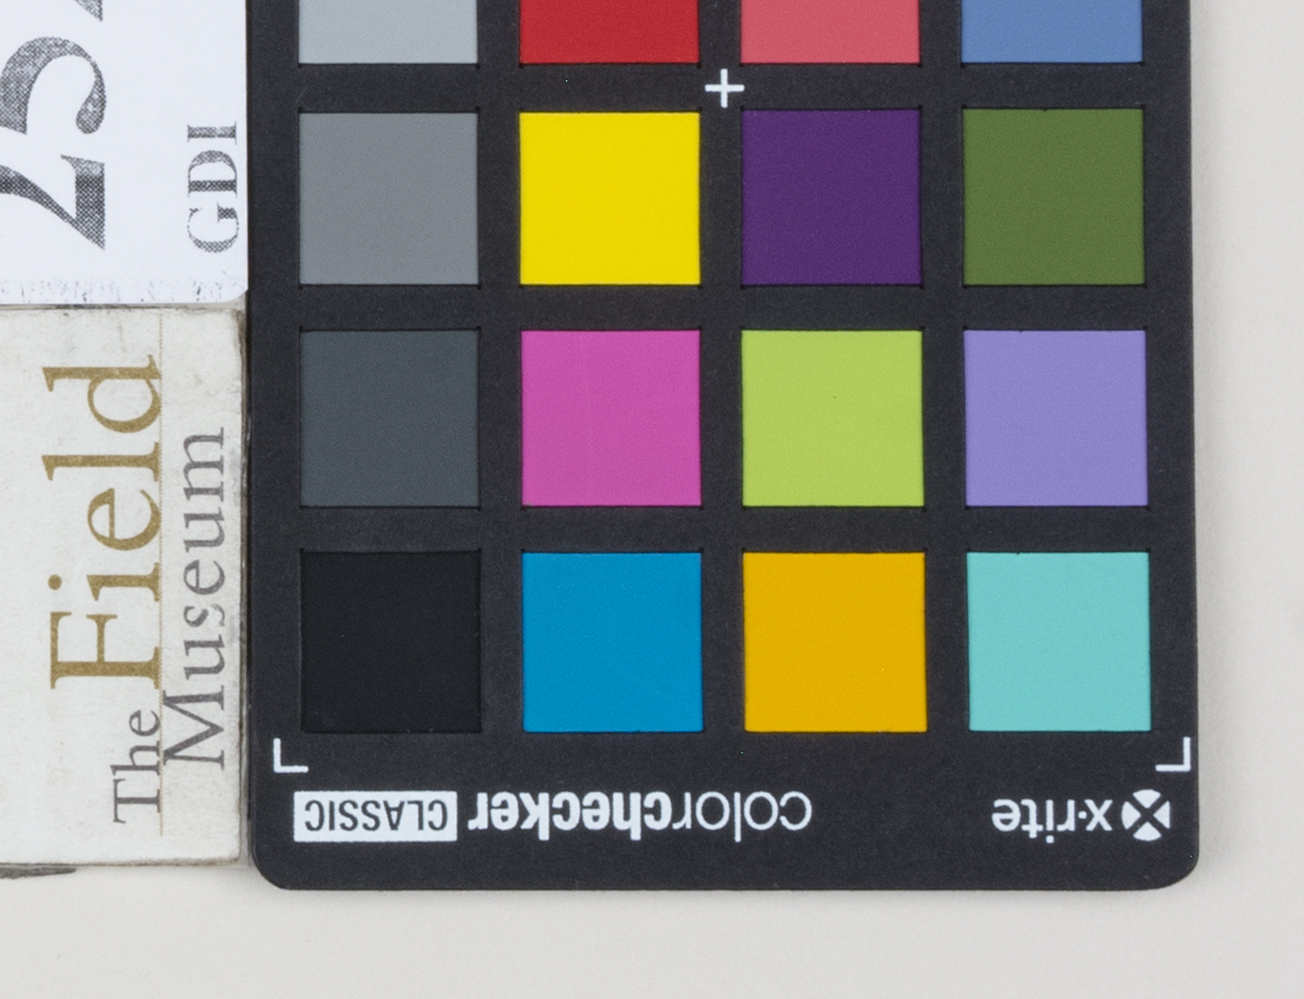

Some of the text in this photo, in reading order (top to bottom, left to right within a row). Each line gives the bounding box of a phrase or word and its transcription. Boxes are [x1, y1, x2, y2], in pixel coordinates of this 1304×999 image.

[186, 122, 239, 253] GDI
[41, 354, 162, 824] The Field
[162, 426, 225, 771] Museum
[305, 791, 812, 843] colorchecker CLASSIC
